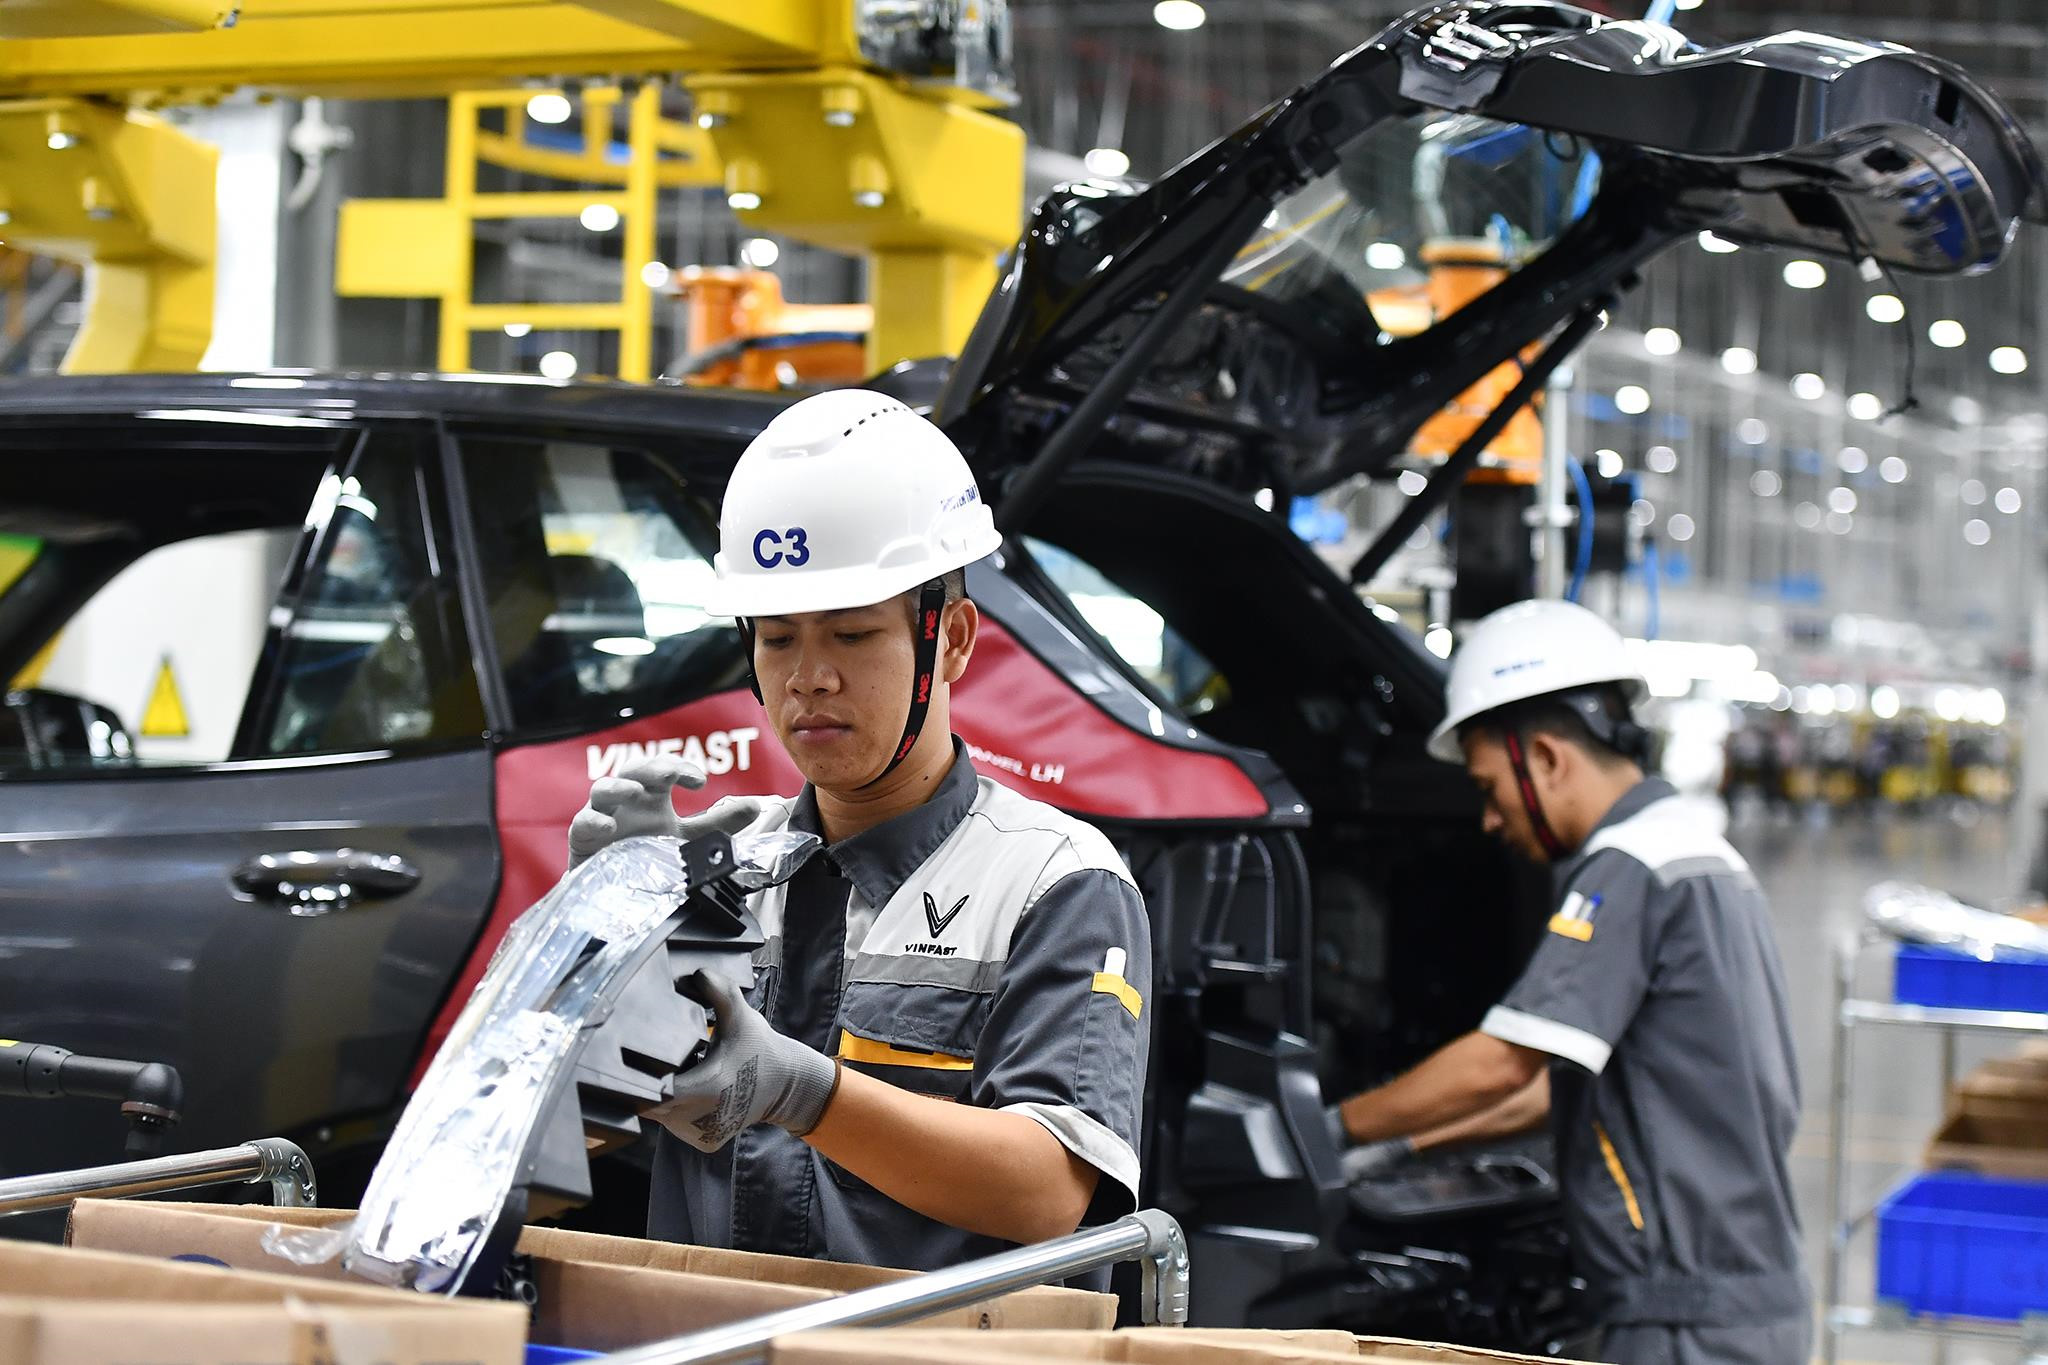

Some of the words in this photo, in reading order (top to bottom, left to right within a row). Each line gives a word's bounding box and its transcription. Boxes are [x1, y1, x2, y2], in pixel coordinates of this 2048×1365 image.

[752, 527, 811, 569] C3
[924, 609, 938, 640] 3M
[917, 673, 931, 704] 3M
[896, 734, 916, 760] 3M
[1030, 763, 1065, 785] LH
[905, 943, 957, 957] VINFAST
